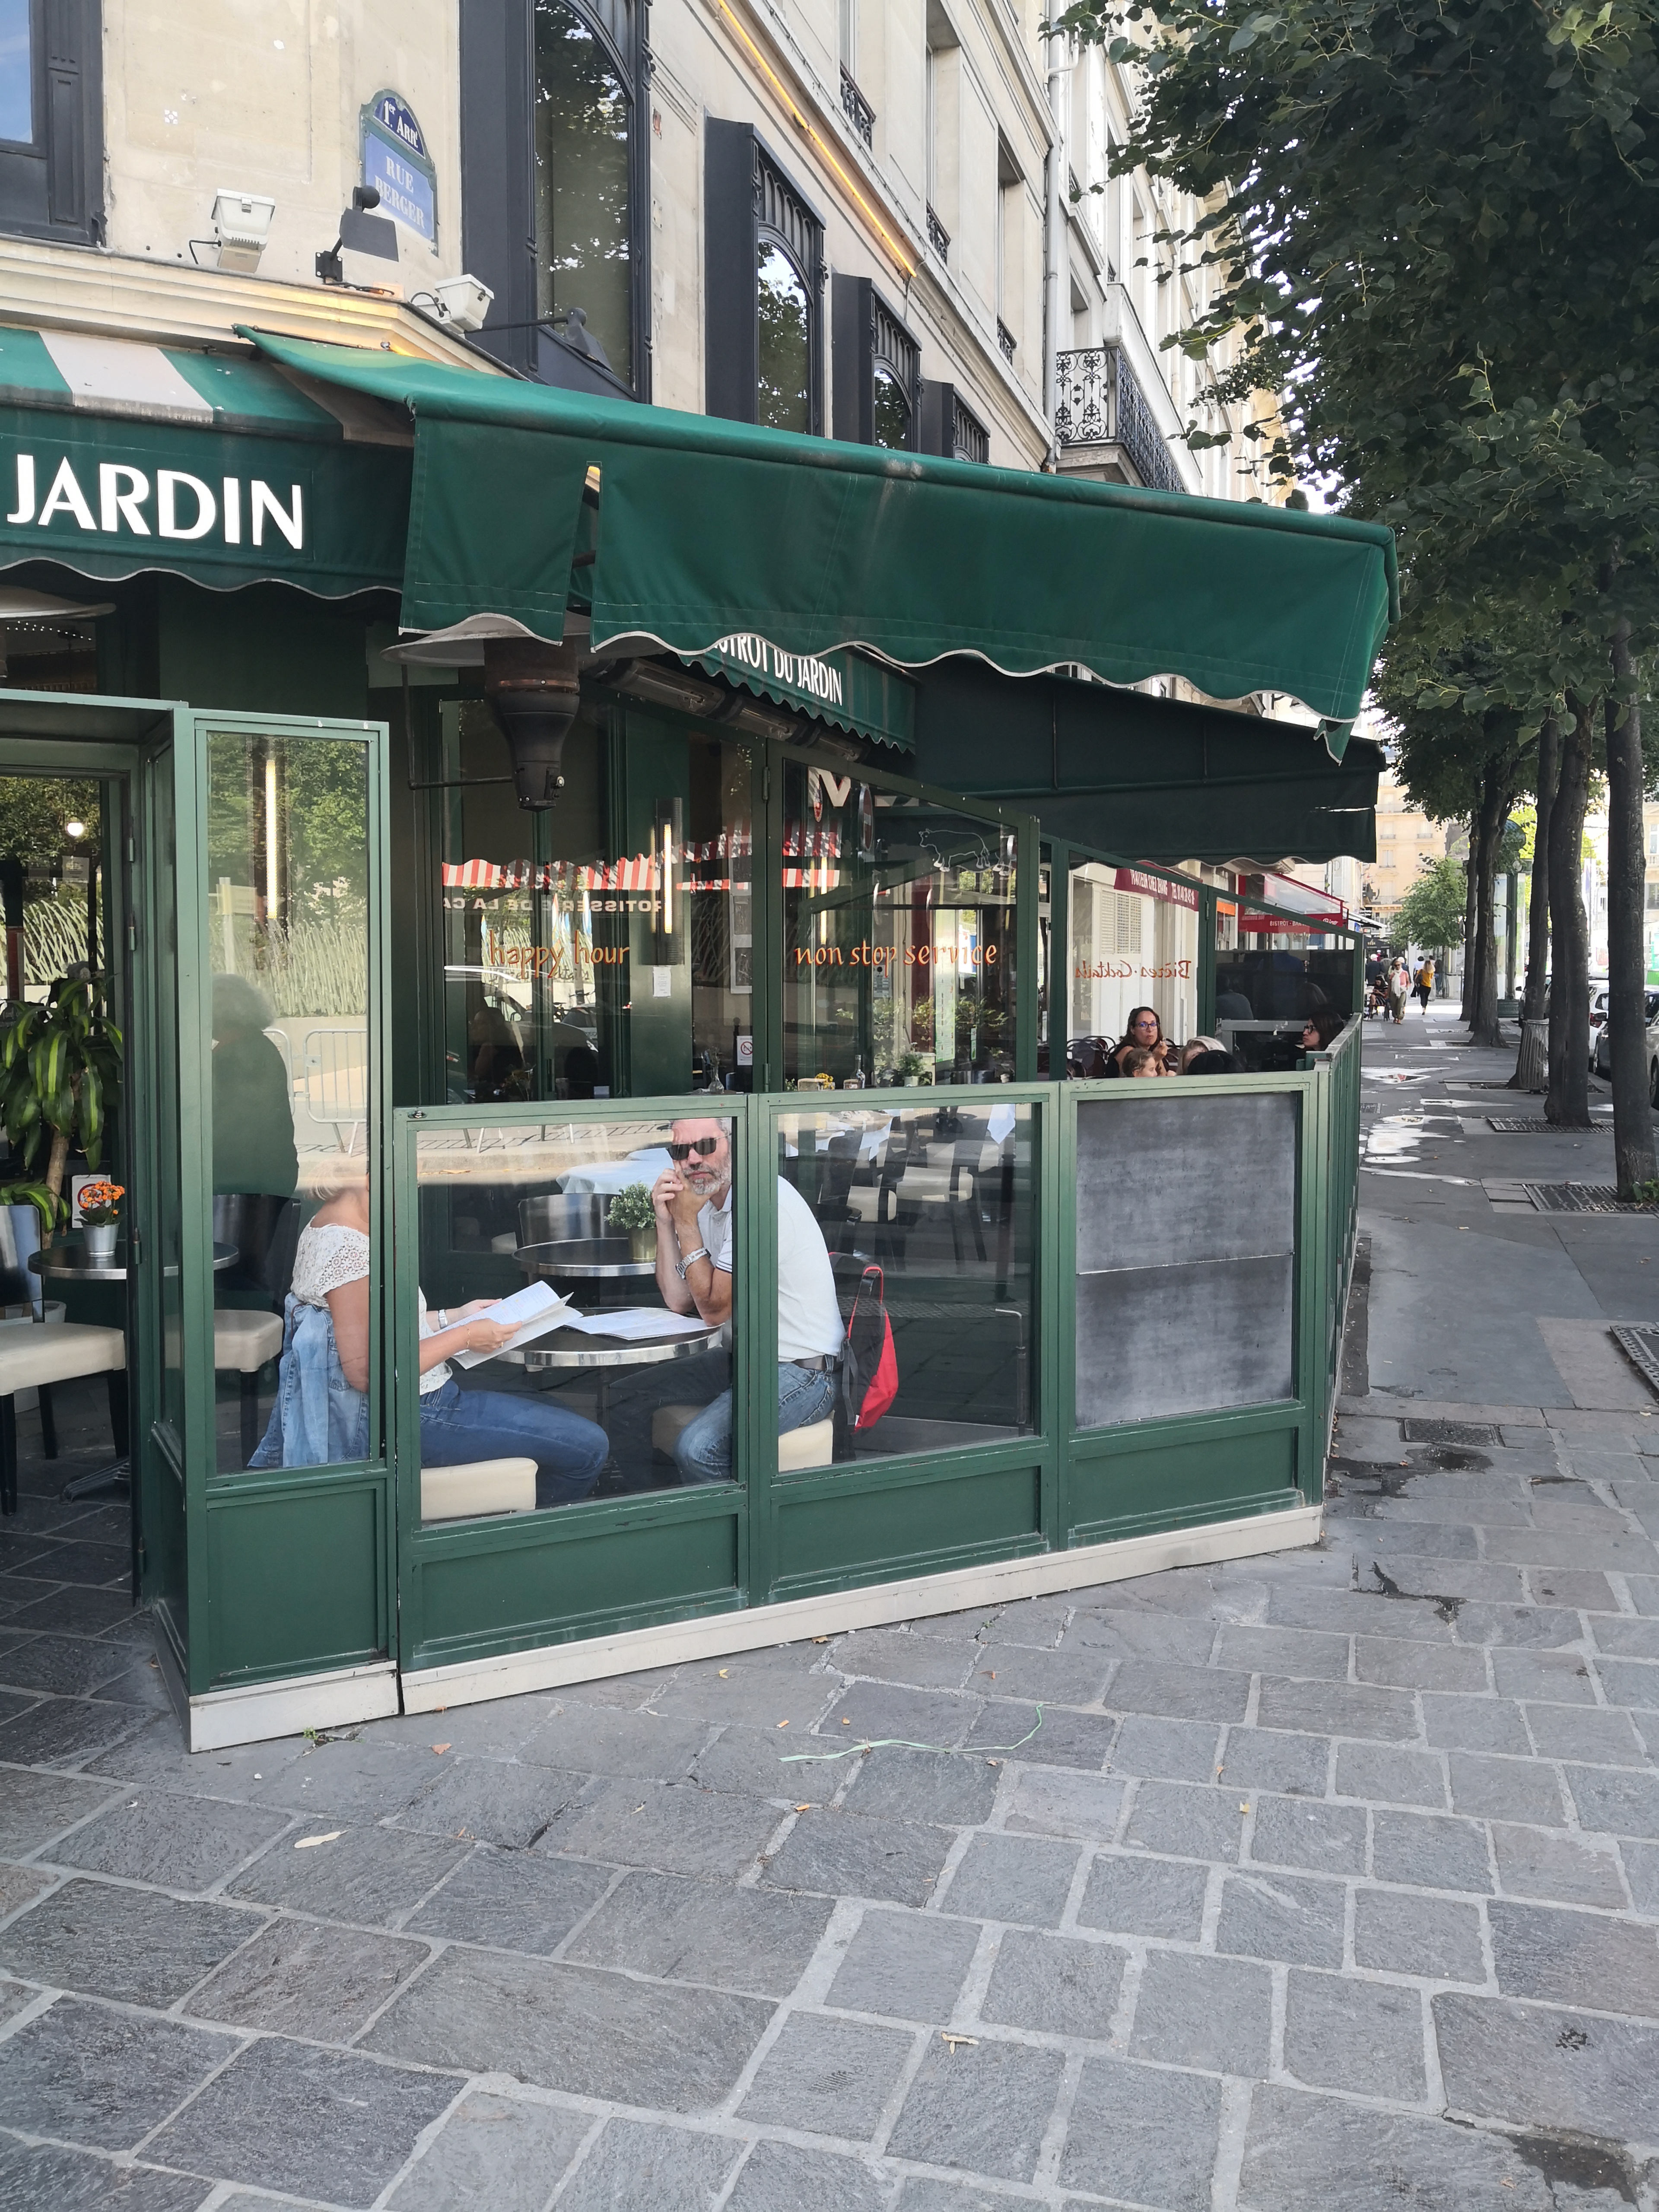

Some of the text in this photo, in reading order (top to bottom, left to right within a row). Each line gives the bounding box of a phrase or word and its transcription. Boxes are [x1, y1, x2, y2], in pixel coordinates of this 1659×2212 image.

[386, 156, 413, 194] RUE
[375, 175, 425, 229] BERGER
[6, 454, 303, 550] JARDIN
[774, 648, 793, 683] DU
[797, 658, 842, 706] JARDIN
[489, 929, 565, 979] happy
[575, 929, 630, 964] hour
[794, 936, 997, 978] non stop service
